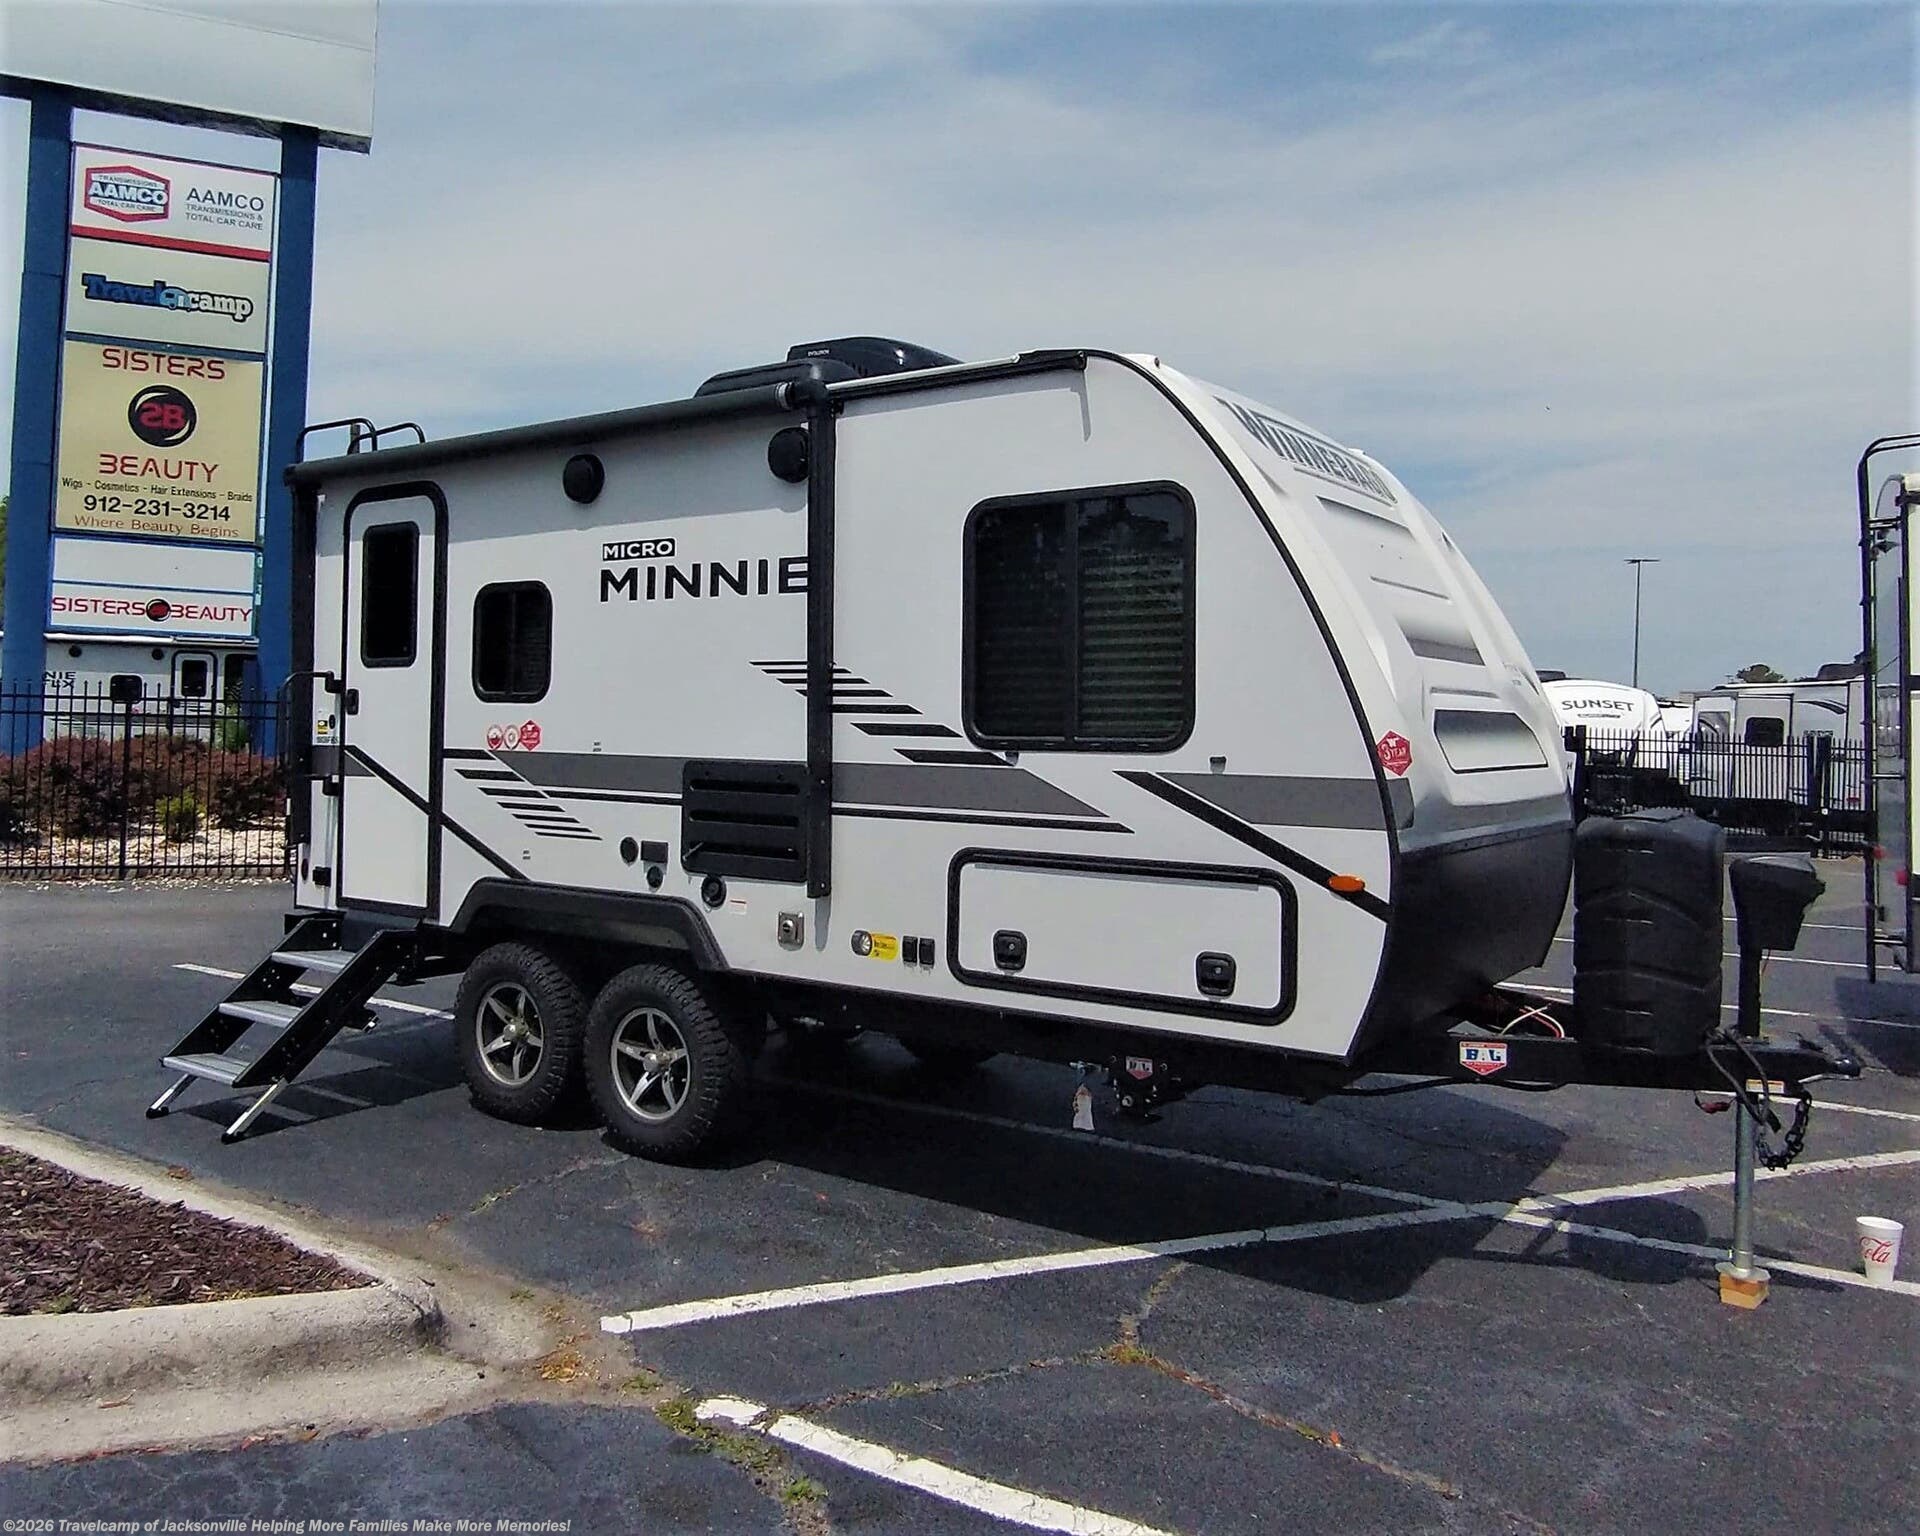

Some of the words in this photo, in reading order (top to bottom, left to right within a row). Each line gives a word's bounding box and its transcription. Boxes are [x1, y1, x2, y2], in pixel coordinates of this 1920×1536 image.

[88, 182, 169, 204] AAMCO
[186, 187, 265, 212] AAMCO
[185, 203, 256, 221] TRANSMISSIONS
[185, 212, 213, 223] TOTAL
[217, 215, 236, 226] CAR
[238, 218, 263, 230] CARE
[102, 348, 226, 380] SISTERS
[99, 453, 219, 483] BEAUTY
[62, 477, 83, 489] Wigs
[94, 480, 139, 493] Cosmetics
[151, 485, 168, 495] Hair
[171, 486, 216, 499] Extensions
[227, 492, 253, 502] Braids
[84, 495, 231, 521] 912-231-3214
[75, 515, 124, 529] Where
[131, 519, 183, 535] Beauty
[191, 525, 240, 538] Begins
[604, 540, 673, 559] MICRO
[600, 557, 809, 602] MINNIE
[52, 597, 146, 616] SISTERS
[170, 604, 252, 622] BEAUTY
[1562, 699, 1635, 712] SUNSET
